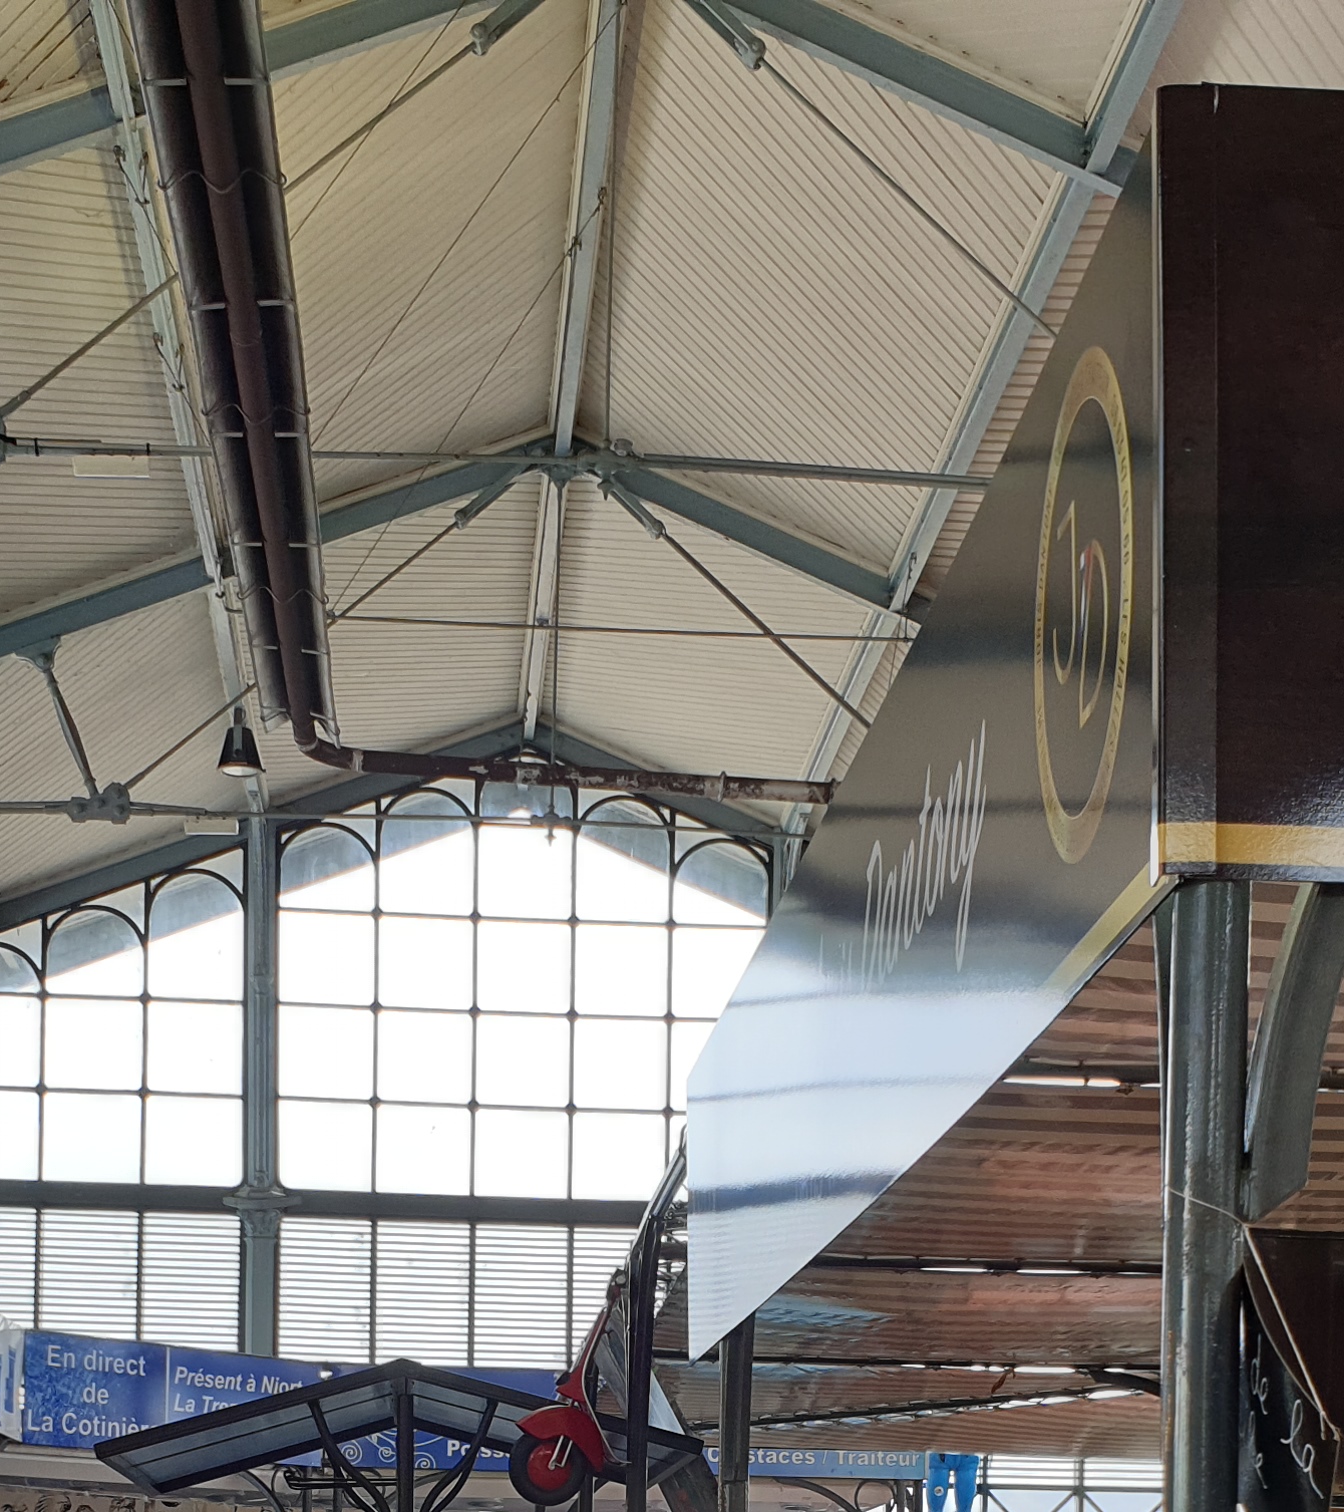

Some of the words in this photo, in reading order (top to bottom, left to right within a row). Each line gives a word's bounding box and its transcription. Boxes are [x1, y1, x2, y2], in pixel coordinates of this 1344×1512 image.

[860, 718, 987, 996] Dantony
[47, 1344, 76, 1370] En
[83, 1350, 147, 1377] direct
[174, 1366, 243, 1393] Présent
[246, 1374, 256, 1393] à
[82, 1382, 110, 1405] de
[173, 1393, 196, 1414] La
[26, 1408, 54, 1433] La
[836, 1450, 921, 1467] Traiteur
